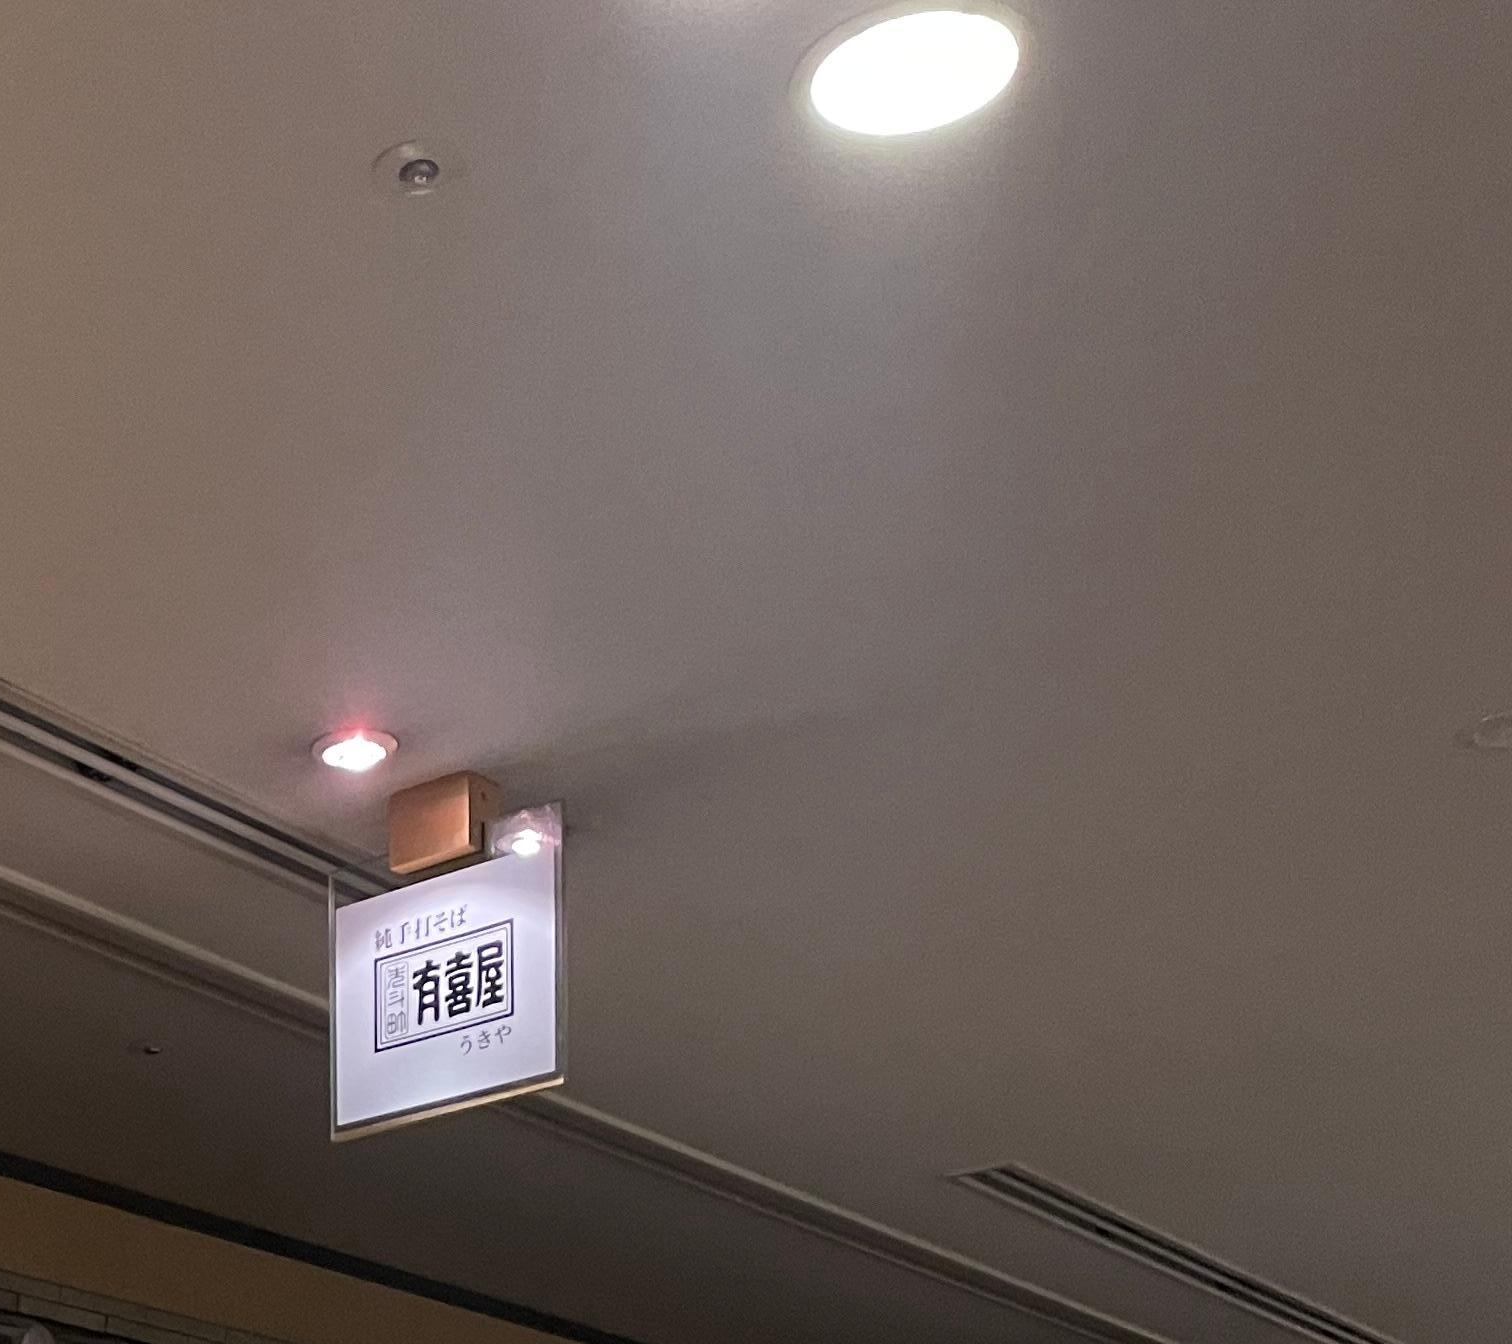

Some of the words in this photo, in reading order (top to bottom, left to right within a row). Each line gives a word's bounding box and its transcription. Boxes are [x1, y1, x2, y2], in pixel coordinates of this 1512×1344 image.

[412, 940, 505, 1026] 有喜屋
[461, 1023, 513, 1056] うきや
